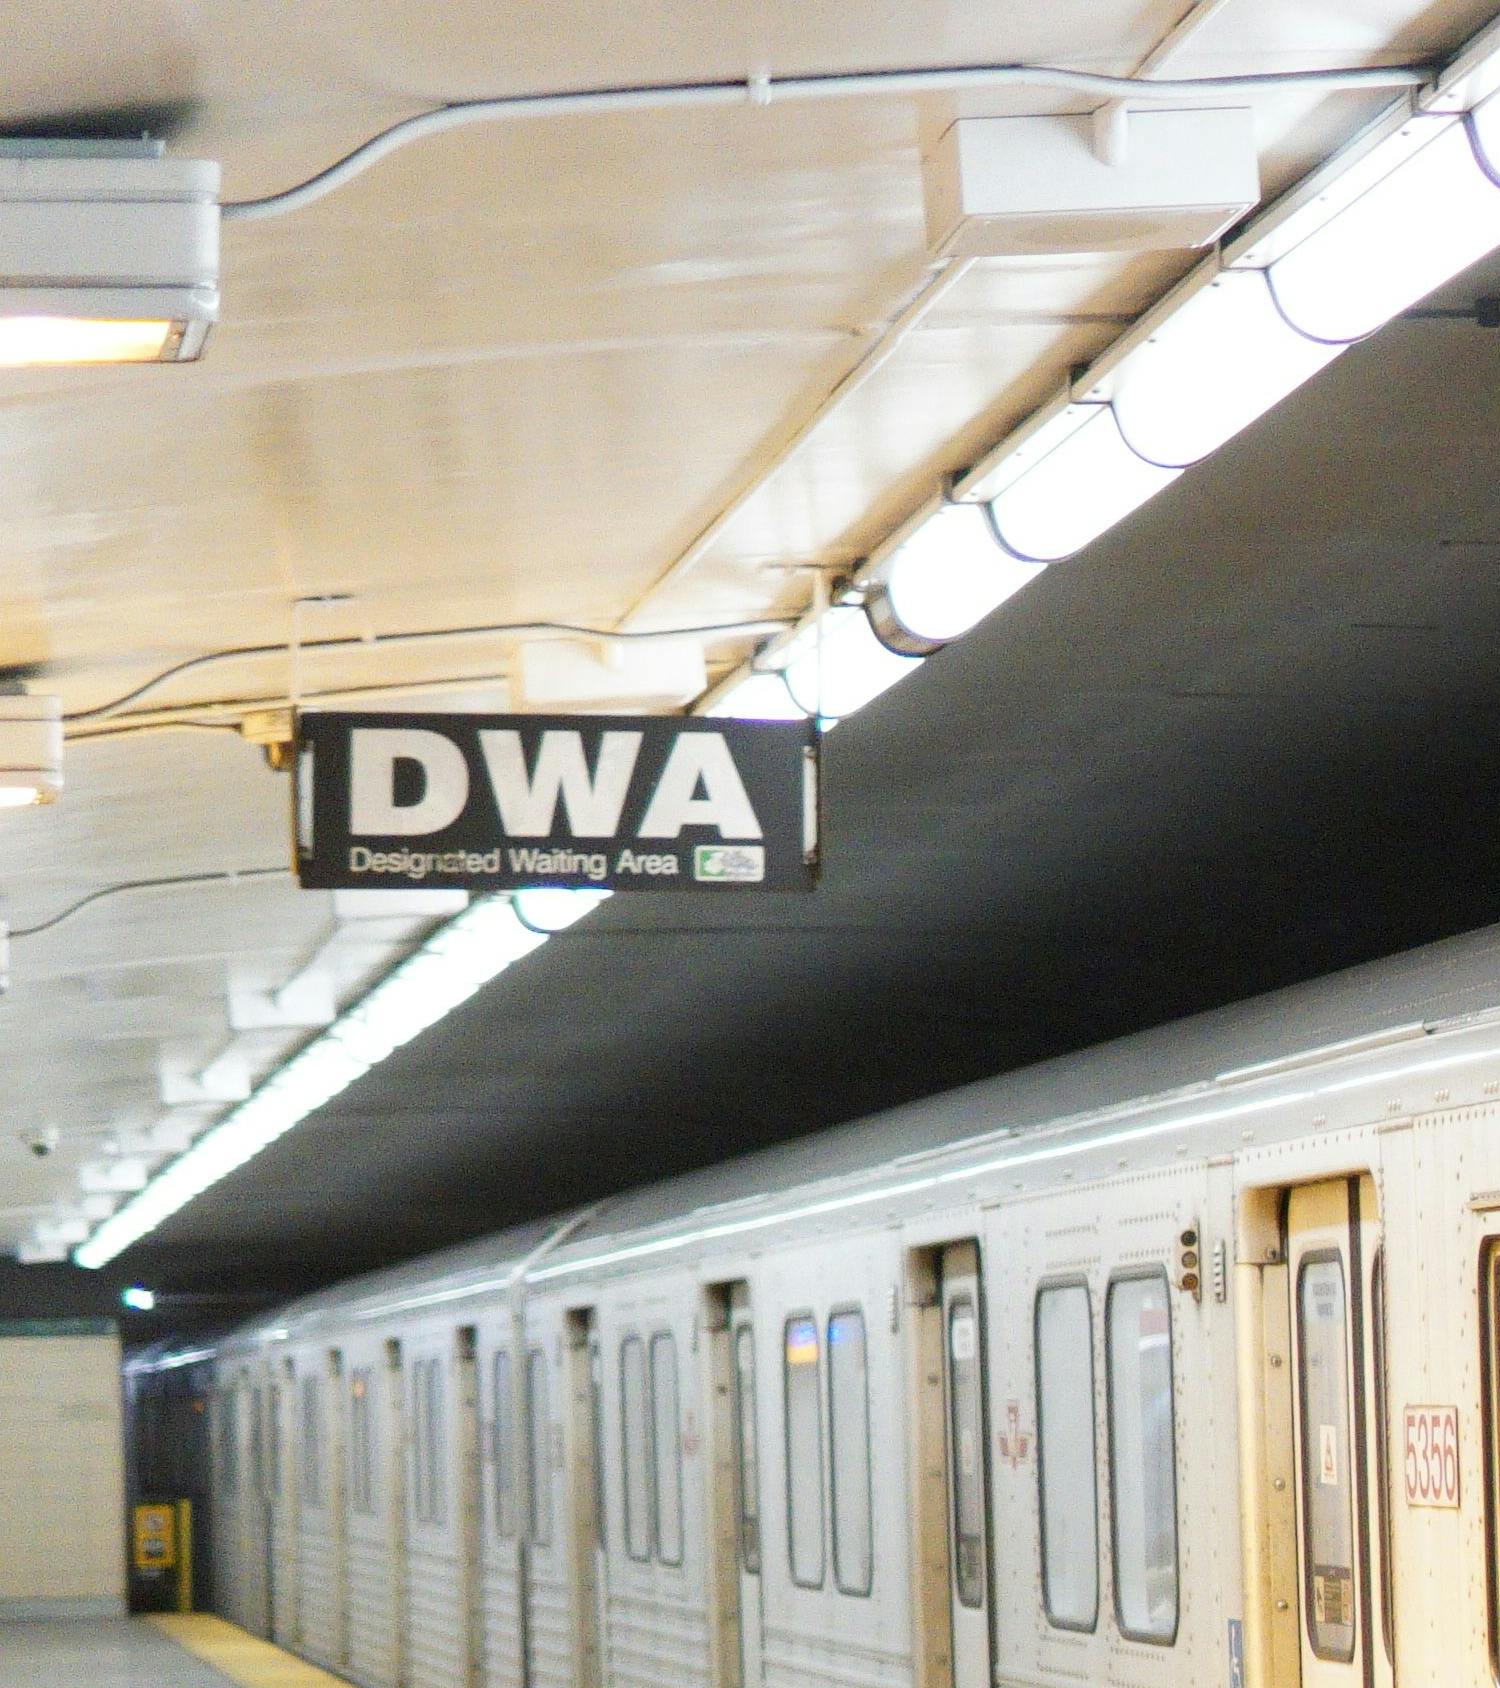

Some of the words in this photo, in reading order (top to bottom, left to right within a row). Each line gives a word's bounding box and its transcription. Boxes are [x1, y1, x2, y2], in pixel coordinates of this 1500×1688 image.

[349, 728, 764, 840] DWA
[349, 846, 501, 878] Designated
[509, 846, 607, 880] Waiting
[616, 848, 679, 875] Area
[1406, 1413, 1456, 1501] 5356
